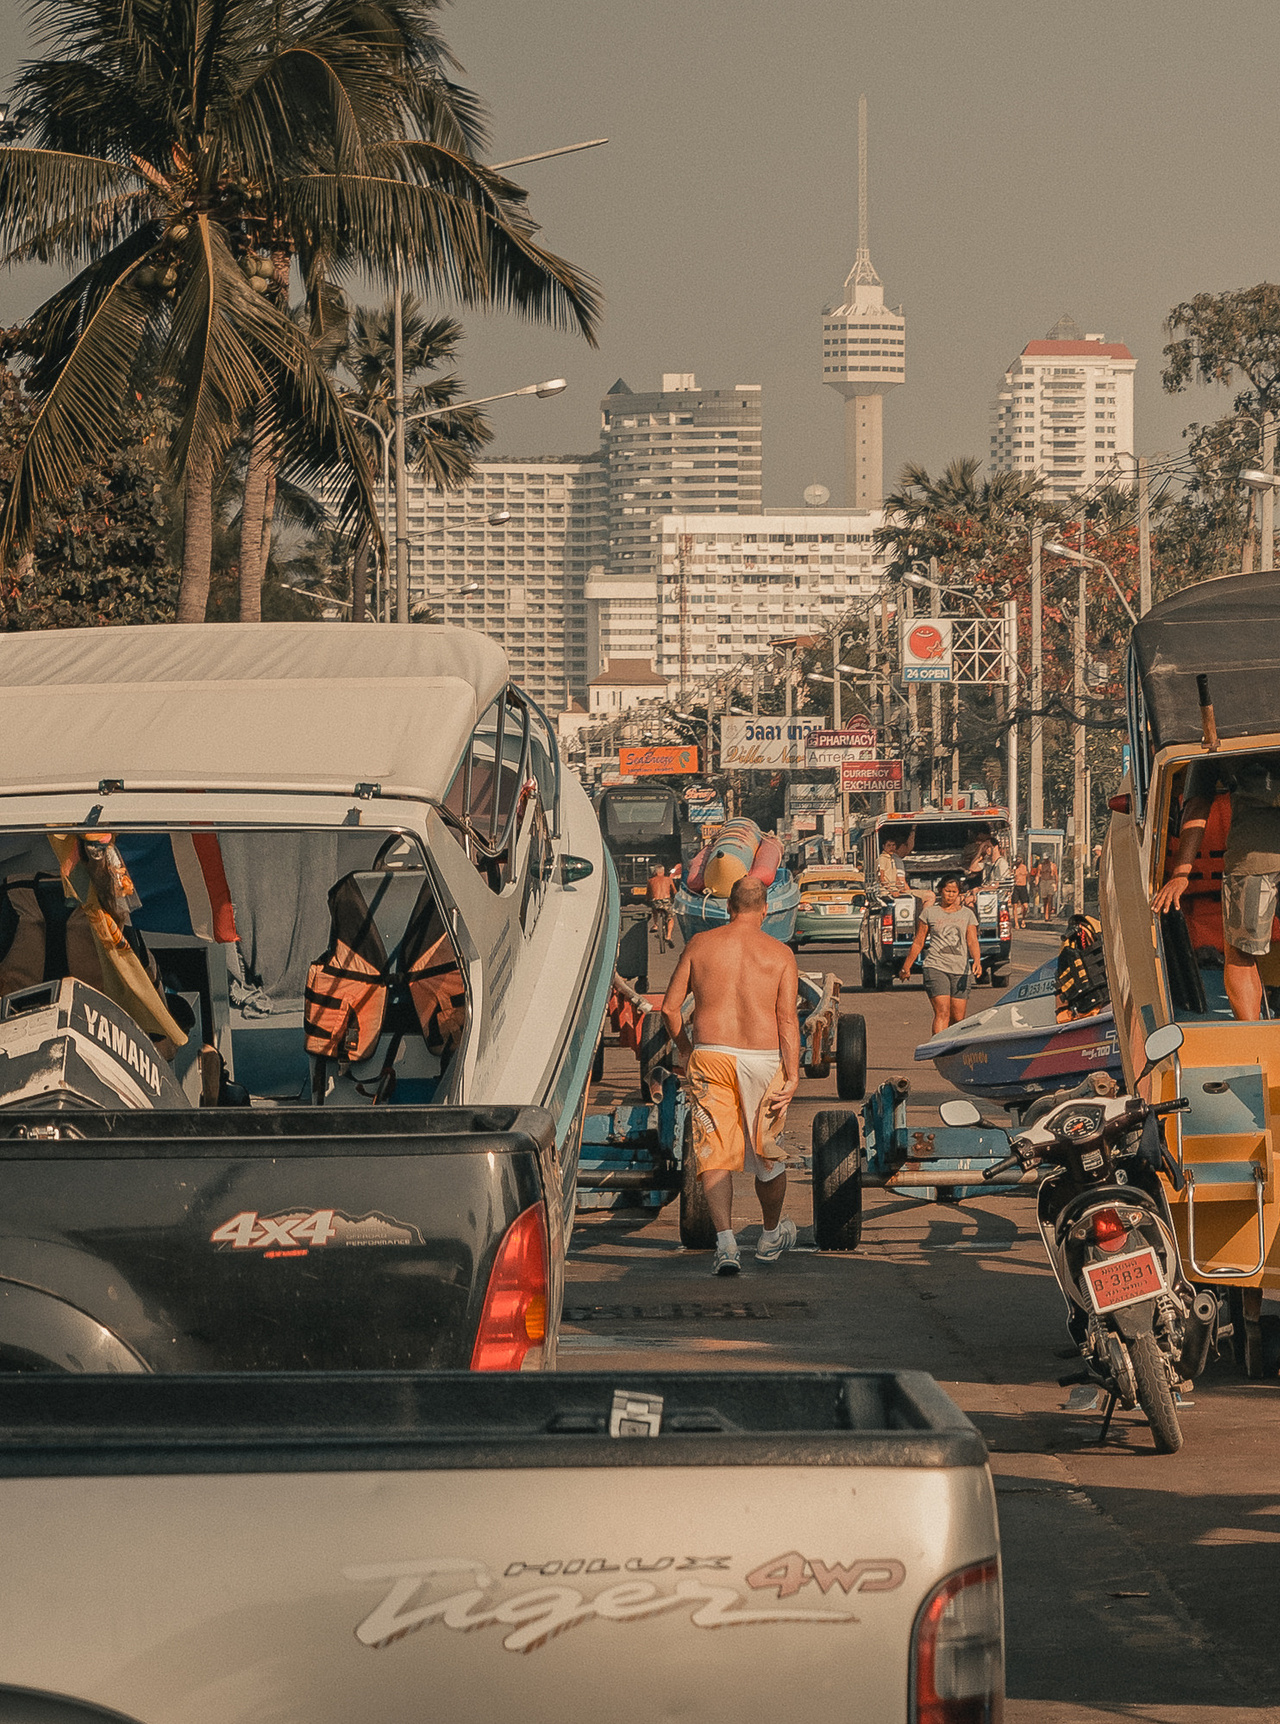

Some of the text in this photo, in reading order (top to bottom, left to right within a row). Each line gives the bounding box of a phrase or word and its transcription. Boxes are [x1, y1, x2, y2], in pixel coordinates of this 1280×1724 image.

[906, 668, 949, 679] 24 OPEN
[745, 720, 782, 741] วิลลา
[787, 720, 822, 741] นาวิ
[819, 734, 875, 746] PHARMACY
[722, 744, 766, 764] Villa
[843, 768, 890, 779] CURRENCY
[843, 780, 901, 791] EXCHANGE
[83, 1002, 162, 1098] YAMAHA
[210, 1209, 337, 1249] 4x4
[502, 1554, 733, 1577] HILUX
[744, 1549, 908, 1598] 4WD
[342, 1556, 862, 1655] Tiger
